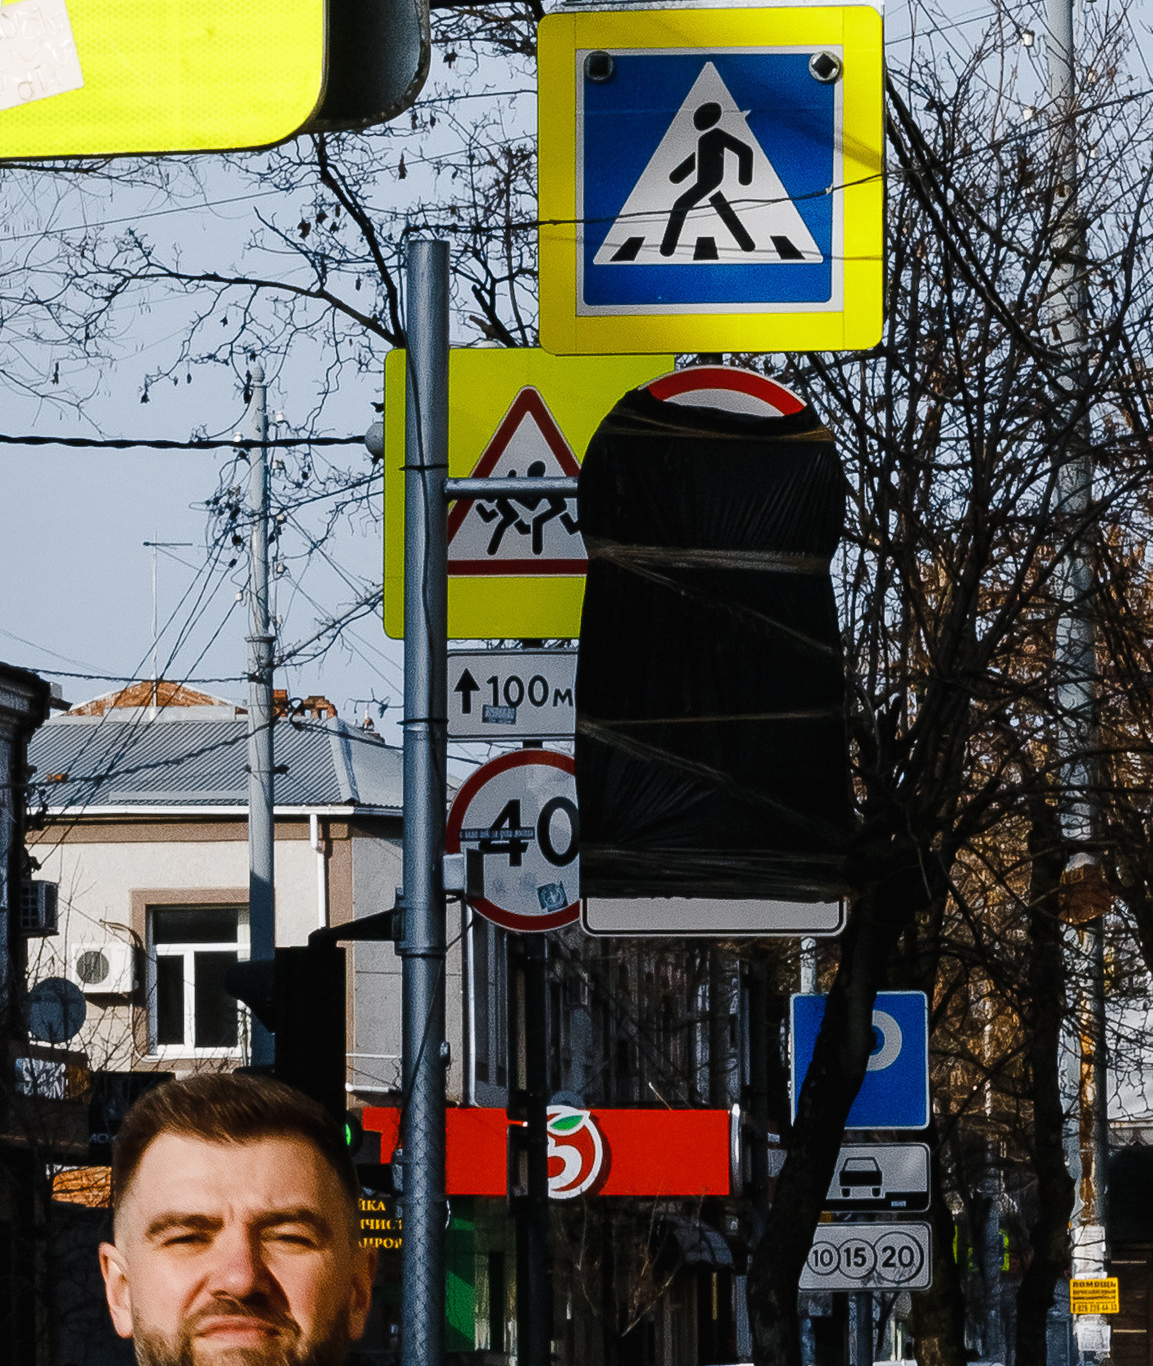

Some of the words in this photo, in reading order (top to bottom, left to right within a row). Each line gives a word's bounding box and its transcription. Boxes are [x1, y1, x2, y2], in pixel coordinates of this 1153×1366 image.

[478, 795, 581, 867] 40
[812, 1248, 833, 1269] 10
[843, 1246, 867, 1268] 15
[881, 1245, 915, 1269] 20
